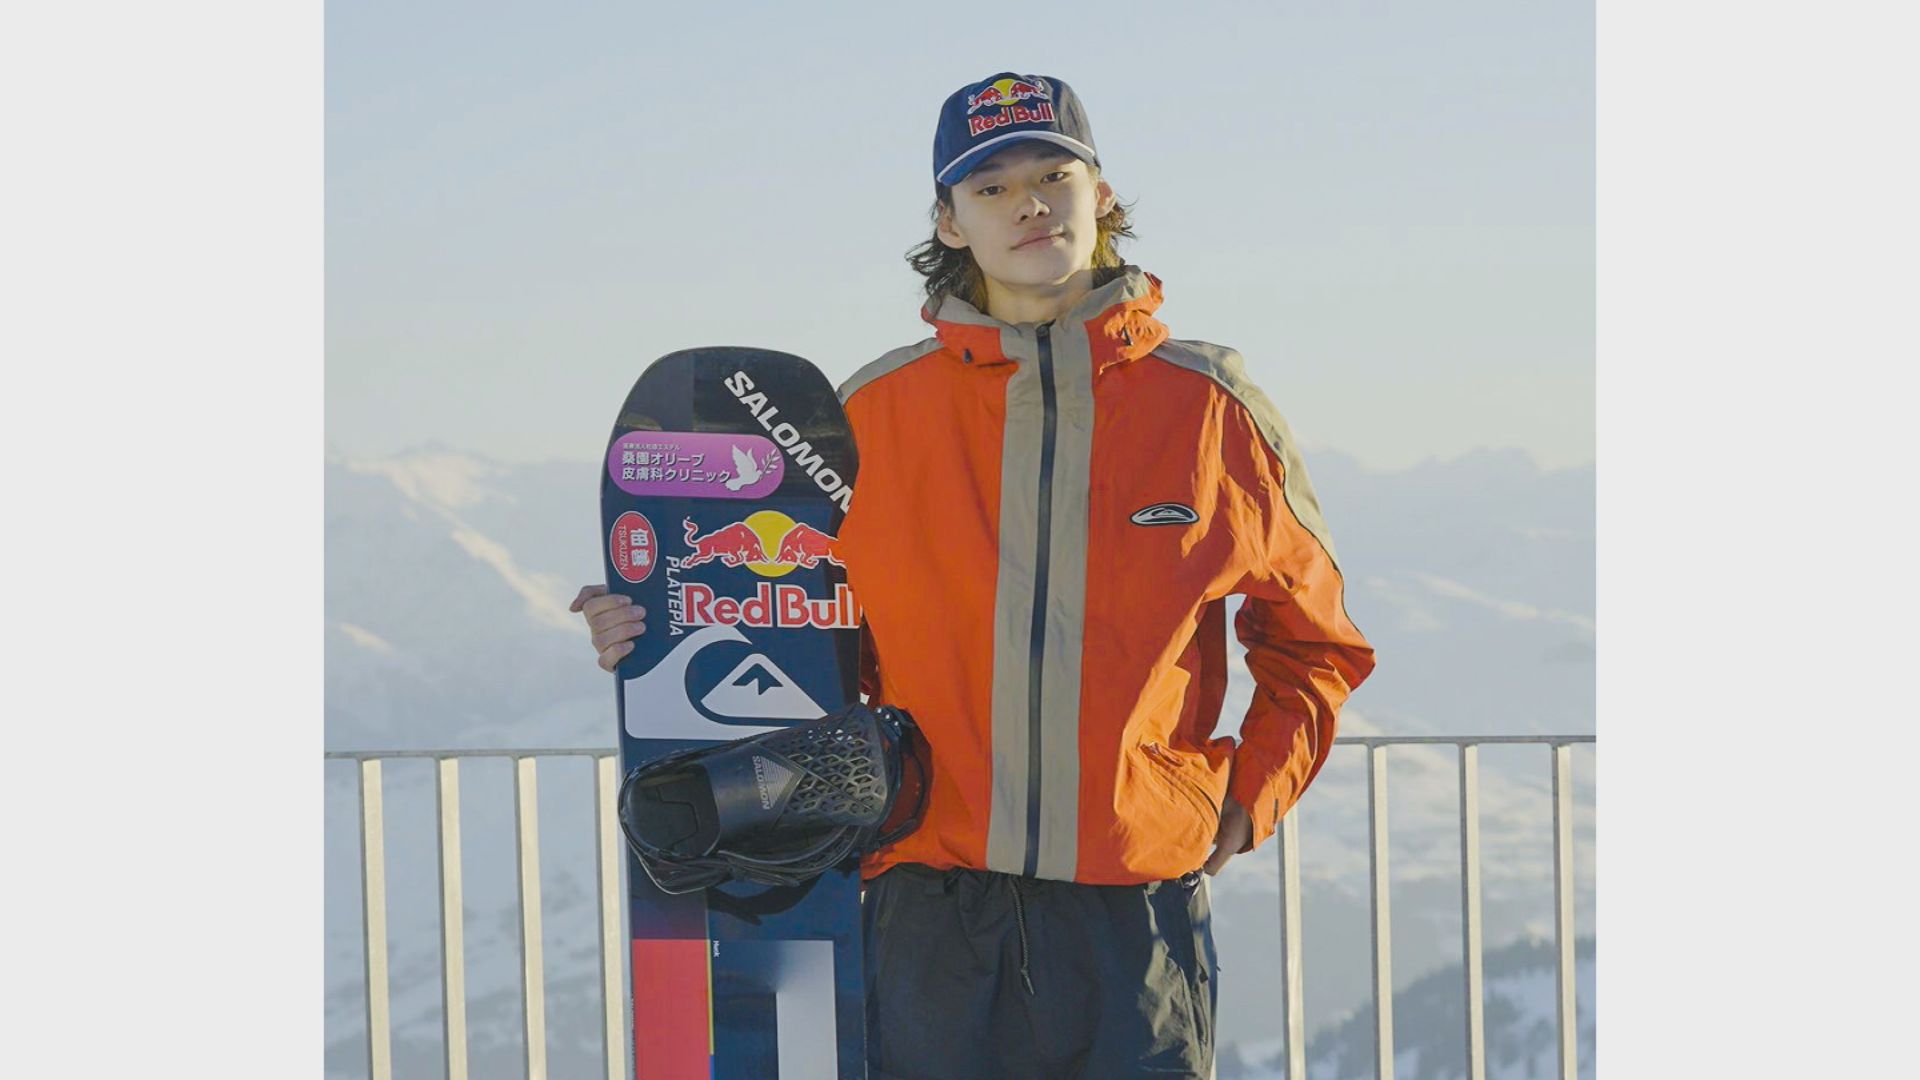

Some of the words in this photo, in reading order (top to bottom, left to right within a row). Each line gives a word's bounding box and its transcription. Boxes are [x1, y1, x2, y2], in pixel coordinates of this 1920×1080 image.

[969, 107, 1011, 136] Red
[1011, 103, 1055, 123] Bull
[724, 371, 854, 514] SALOMON
[622, 467, 731, 483] 皮膚科クリニック
[618, 524, 629, 571] TSUKUZEN
[665, 555, 684, 636] PLATEPIA
[680, 582, 774, 628] Red
[776, 582, 863, 629] Bull
[752, 755, 771, 810] SALOMON
